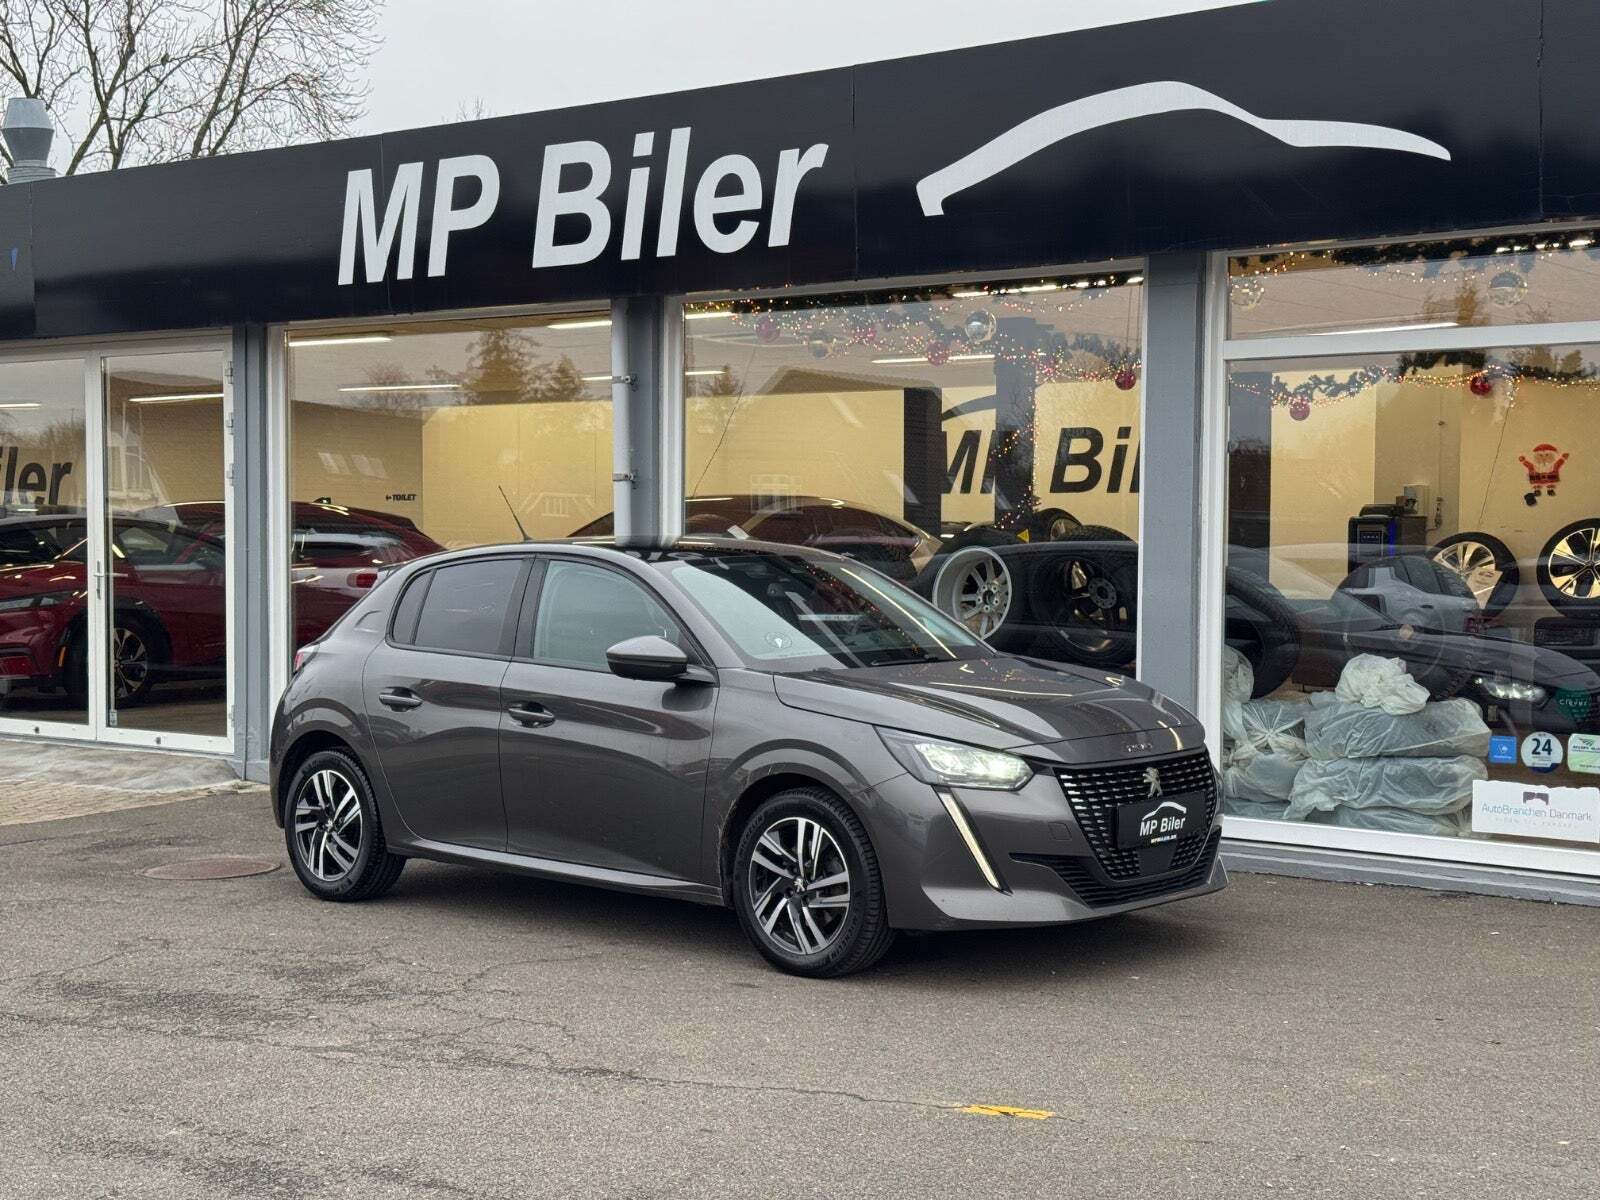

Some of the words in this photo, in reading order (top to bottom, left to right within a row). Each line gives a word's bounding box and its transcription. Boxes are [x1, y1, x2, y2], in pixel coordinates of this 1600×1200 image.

[338, 154, 500, 286] MP
[532, 127, 829, 269] Biler
[0, 446, 73, 506] ler
[392, 493, 417, 502] TOILET
[1531, 737, 1552, 756] 24
[1481, 802, 1546, 818] AutoBranchen
[1549, 808, 1592, 822] Danmark
[1140, 820, 1158, 836] MP
[1160, 816, 1186, 833] Biler
